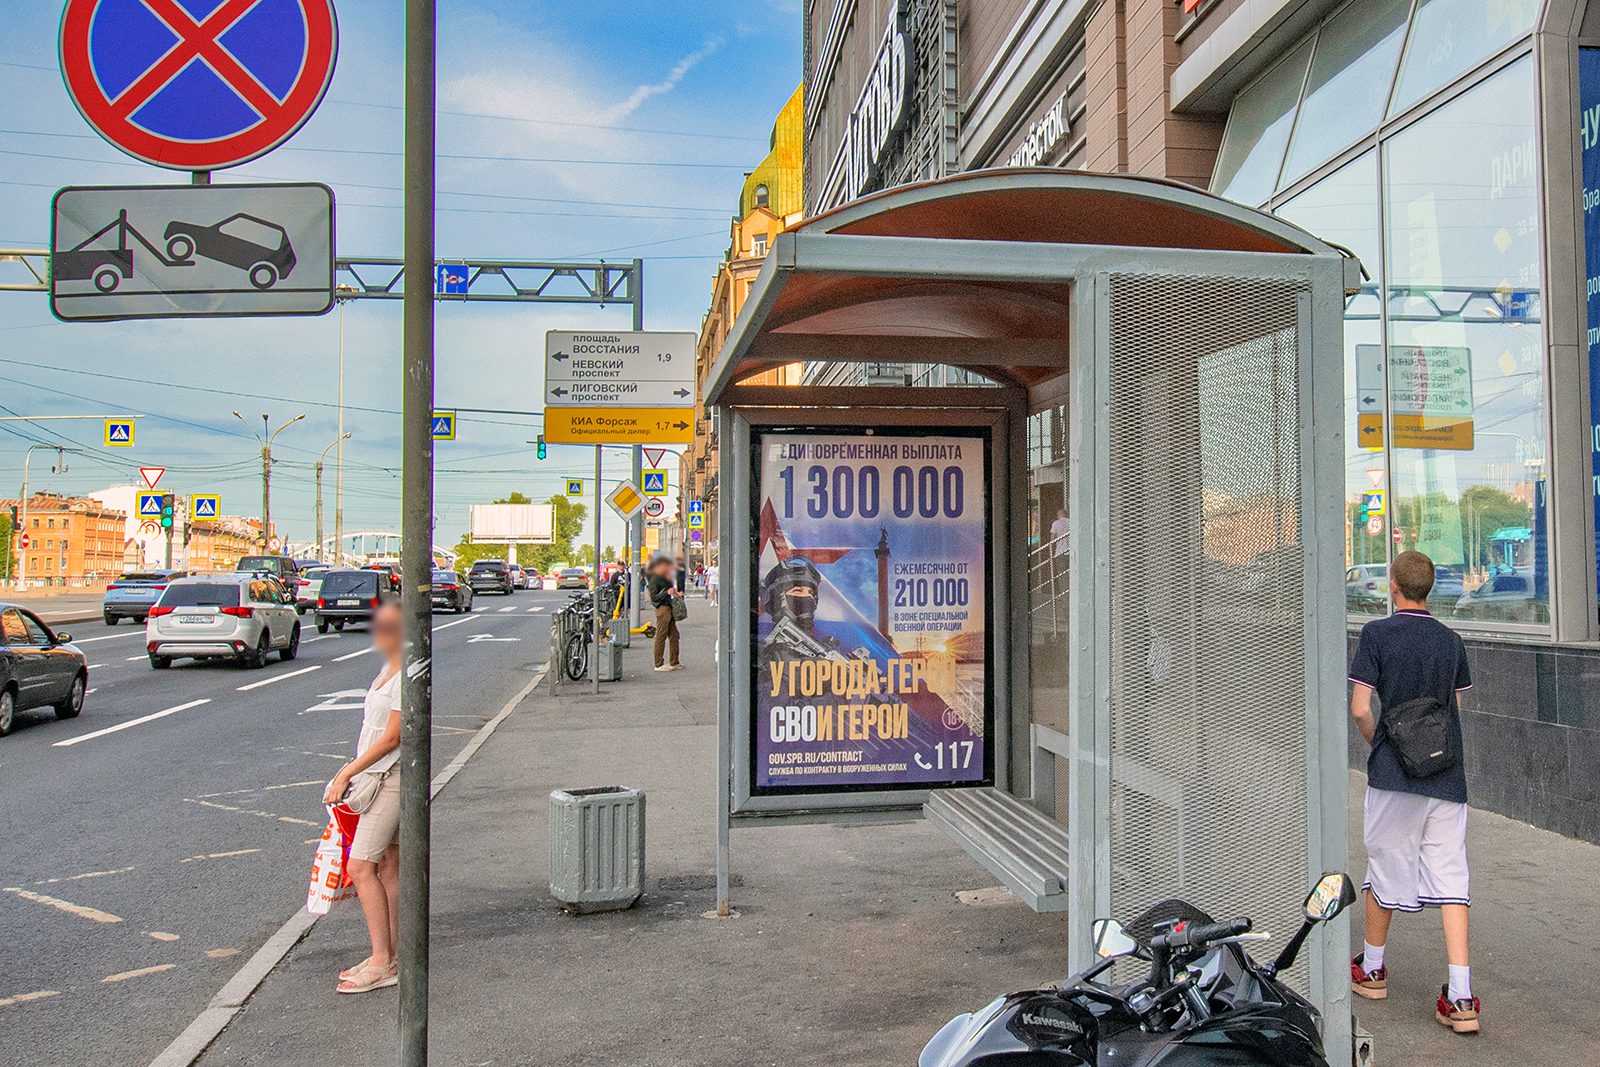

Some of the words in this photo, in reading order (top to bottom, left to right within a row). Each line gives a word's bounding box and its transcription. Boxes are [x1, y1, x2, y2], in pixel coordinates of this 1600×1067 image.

[573, 335, 621, 343] площадь
[573, 345, 640, 354] ВОССТАНИЯ
[657, 353, 672, 363] 1,9
[572, 359, 624, 369] НЕВСКИЙ
[572, 370, 620, 378] проспект
[571, 383, 638, 393] ЛИГОВСКИЙ
[571, 394, 620, 402] проспект
[571, 417, 593, 426] КИА
[596, 417, 638, 427] Форсаж
[656, 422, 670, 431] 1,7
[571, 427, 626, 435] Официальный
[781, 443, 898, 461] ЕДИНОВРЕМЕННАЯ
[902, 444, 962, 460] ВЫПЛАТА
[780, 465, 794, 519] 1
[807, 465, 880, 519] 300
[893, 465, 964, 519] 000
[894, 563, 956, 575] ЕЖЕМЕСЯЧНО
[957, 563, 969, 574] ОТ
[894, 578, 928, 607] 210
[933, 578, 969, 606] 000
[894, 612, 900, 621] В
[900, 612, 918, 621] ЗОНЕ
[919, 610, 969, 621] СПЕЦИАЛЬНОЙ
[894, 622, 926, 632] ВОЕННОЙ
[926, 622, 962, 632] ОПЕРАЦИИ
[769, 660, 785, 697] У
[769, 705, 833, 743] СВОИ
[837, 703, 909, 741] ГЕРОИ
[768, 750, 864, 765] GOV.SPB.RU/CONTRACT
[934, 741, 974, 770] 117
[768, 766, 794, 776] СЛУЖБА
[795, 766, 803, 775] ПО
[804, 765, 836, 774] КОНТРАКТУ
[837, 765, 842, 774] В
[842, 764, 887, 774] ВООРУЖЕННЫХ
[888, 763, 907, 772] СИЛАХ
[1022, 1013, 1084, 1034] Kawasaki
